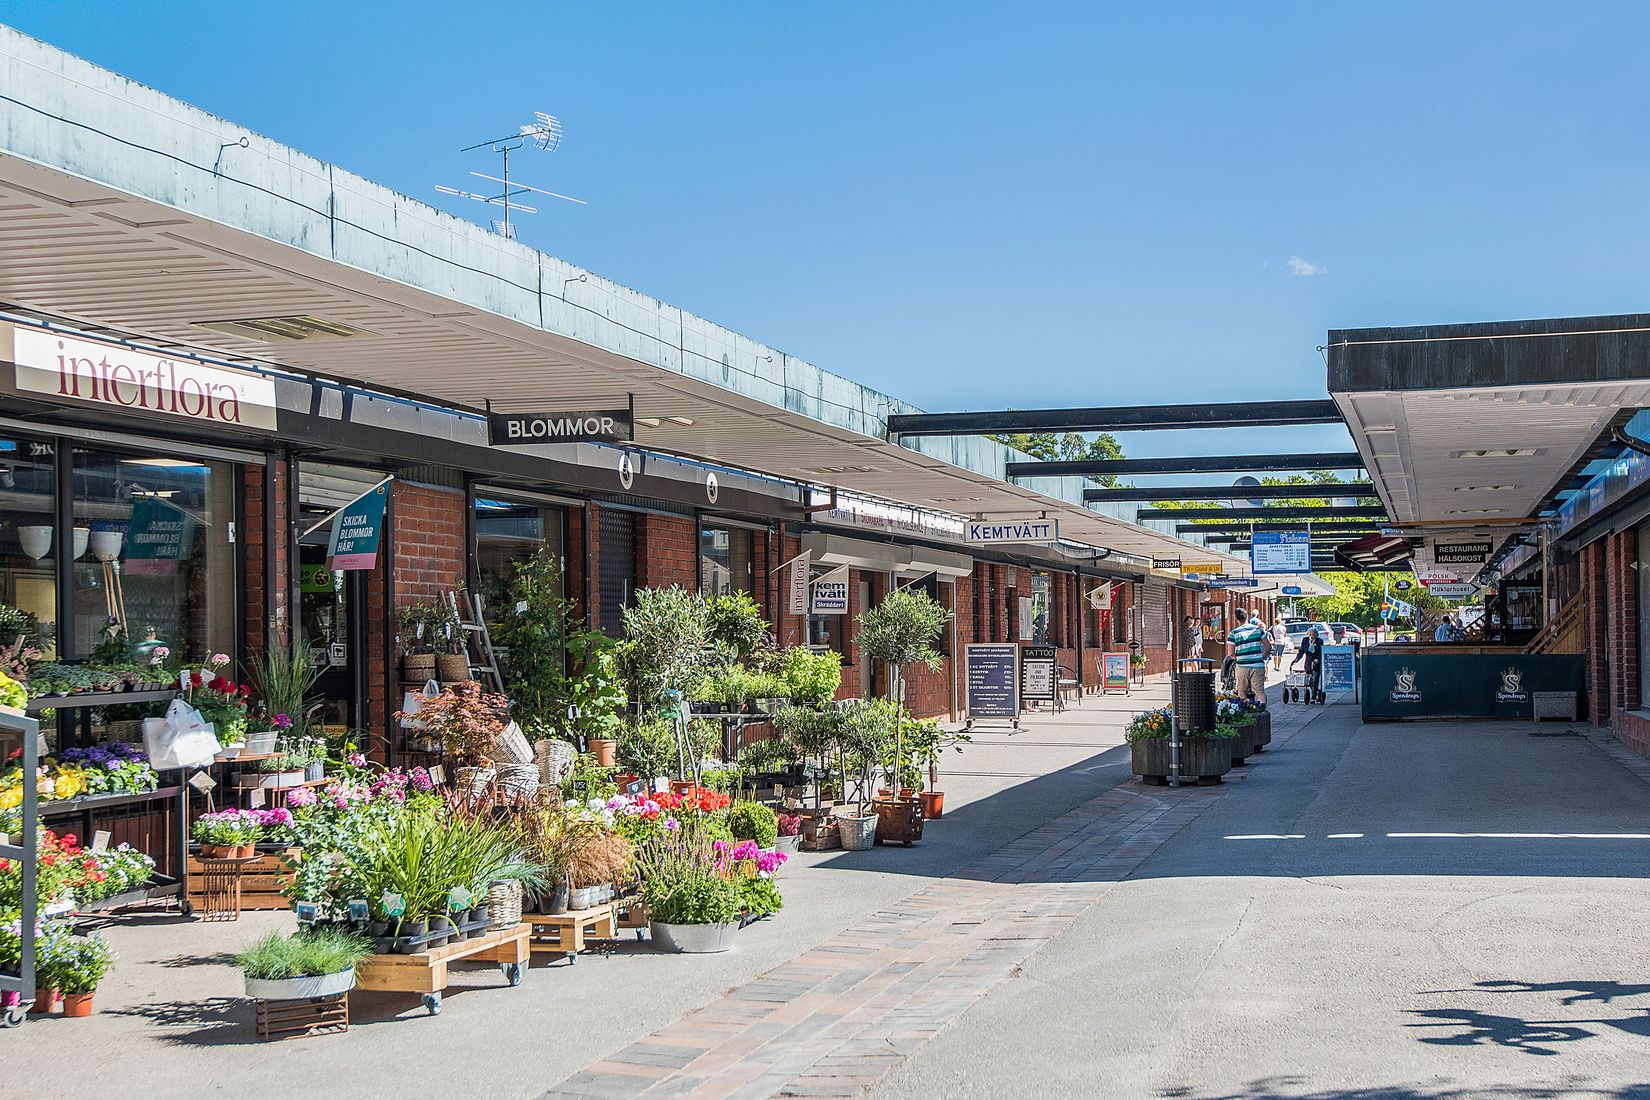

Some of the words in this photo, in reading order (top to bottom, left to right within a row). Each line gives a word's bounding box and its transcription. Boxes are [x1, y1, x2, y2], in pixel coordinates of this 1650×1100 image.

[56, 340, 241, 423] interflora
[507, 416, 614, 438] BLOMMOR
[342, 514, 367, 527] SKICKA
[340, 526, 374, 540] BLOMMOR
[970, 521, 1050, 540] KEMTVÄTT
[337, 539, 354, 552] HÄR!
[1439, 544, 1488, 553] RESTAURANG
[1153, 560, 1180, 568] FRISÖR
[1438, 553, 1482, 562] HÄLSOKOST
[793, 559, 805, 612] interflora
[815, 589, 846, 598] tvätt
[1024, 649, 1054, 657] TATTOO
